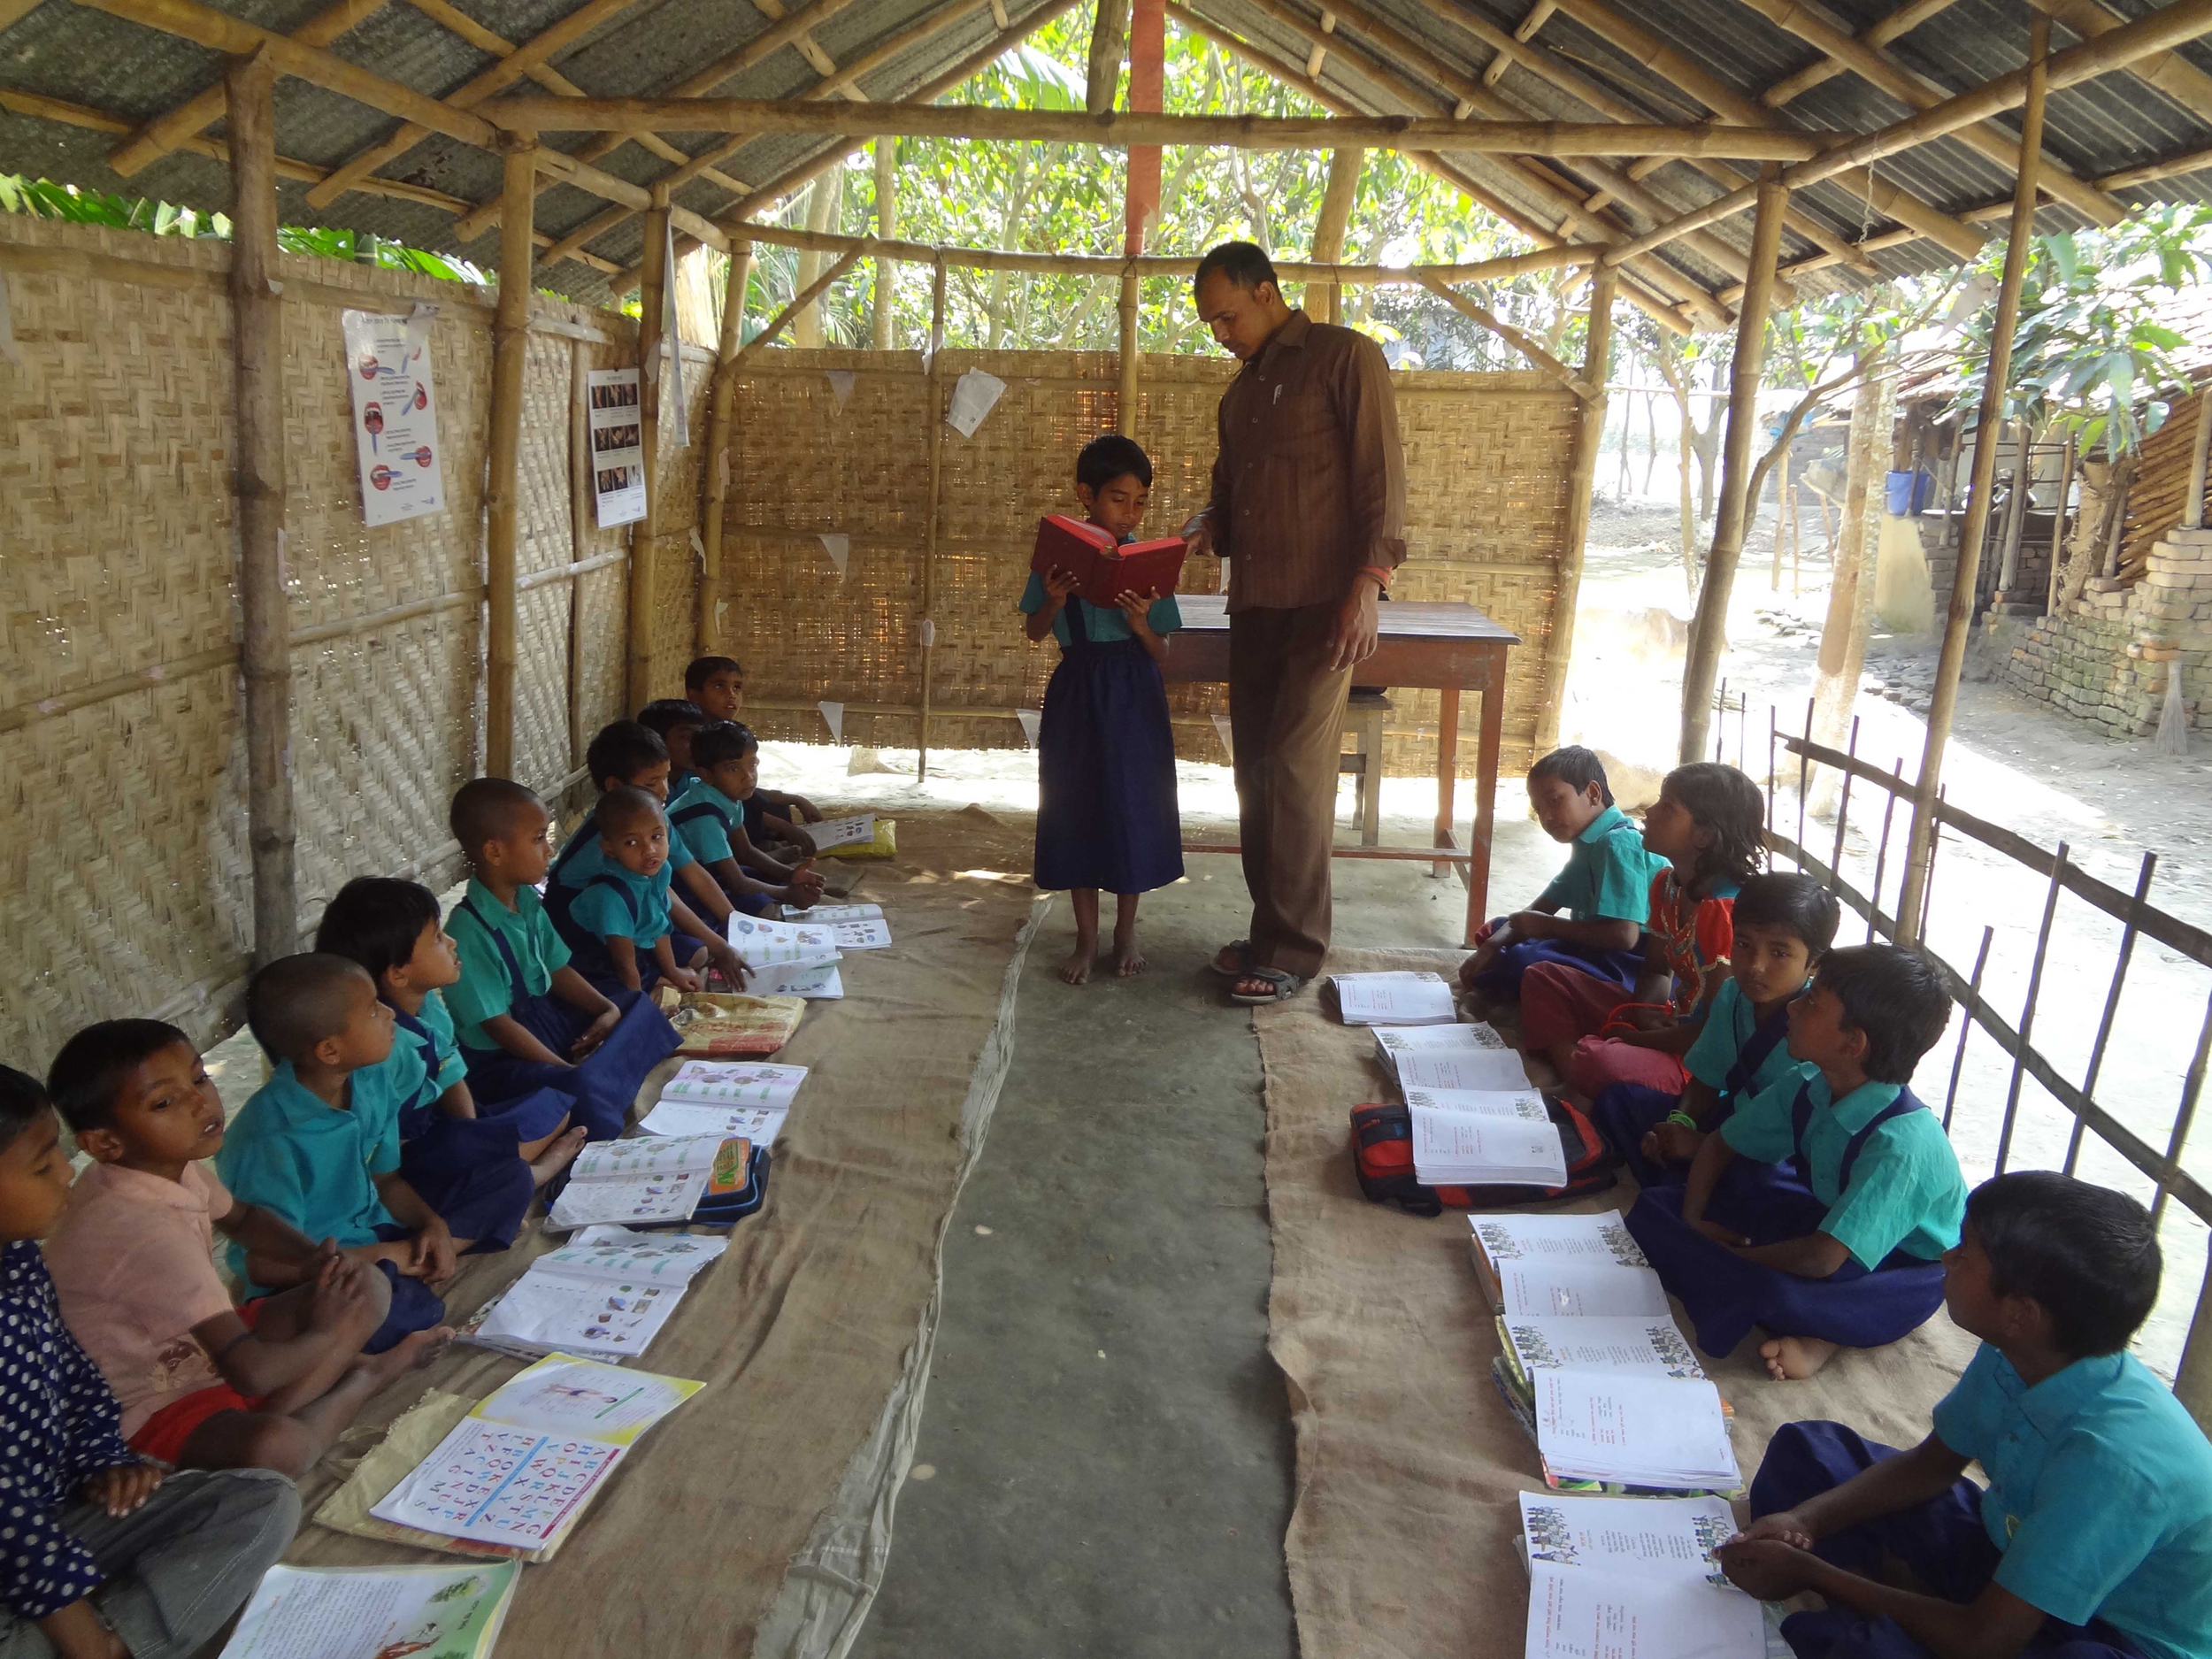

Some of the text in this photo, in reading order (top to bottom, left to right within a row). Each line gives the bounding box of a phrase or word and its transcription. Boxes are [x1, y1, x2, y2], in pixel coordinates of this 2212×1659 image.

[521, 1437, 535, 1446] H
[564, 1443, 577, 1452] O
[578, 1445, 593, 1455] H
[475, 1455, 486, 1465] C
[487, 1459, 501, 1468] Q
[530, 1458, 547, 1471] W
[449, 1464, 461, 1473] G
[540, 1468, 556, 1478] Q
[477, 1471, 492, 1481] W
[488, 1473, 503, 1482] K
[573, 1473, 587, 1483] C
[449, 1480, 465, 1489] N
[513, 1477, 530, 1486] X
[530, 1481, 545, 1490] R
[429, 1481, 447, 1493] M
[465, 1484, 479, 1493] D
[480, 1486, 491, 1495] E
[545, 1483, 560, 1493] K
[438, 1494, 451, 1502] U
[550, 1498, 565, 1507] E
[426, 1506, 441, 1515] Y
[443, 1509, 454, 1518] P
[521, 1509, 539, 1518] M
[541, 1510, 554, 1519] F
[453, 1511, 467, 1520] R
[480, 1513, 495, 1523] Z
[495, 1519, 511, 1529] U
[509, 1522, 526, 1532] N
[526, 1525, 541, 1534] G
